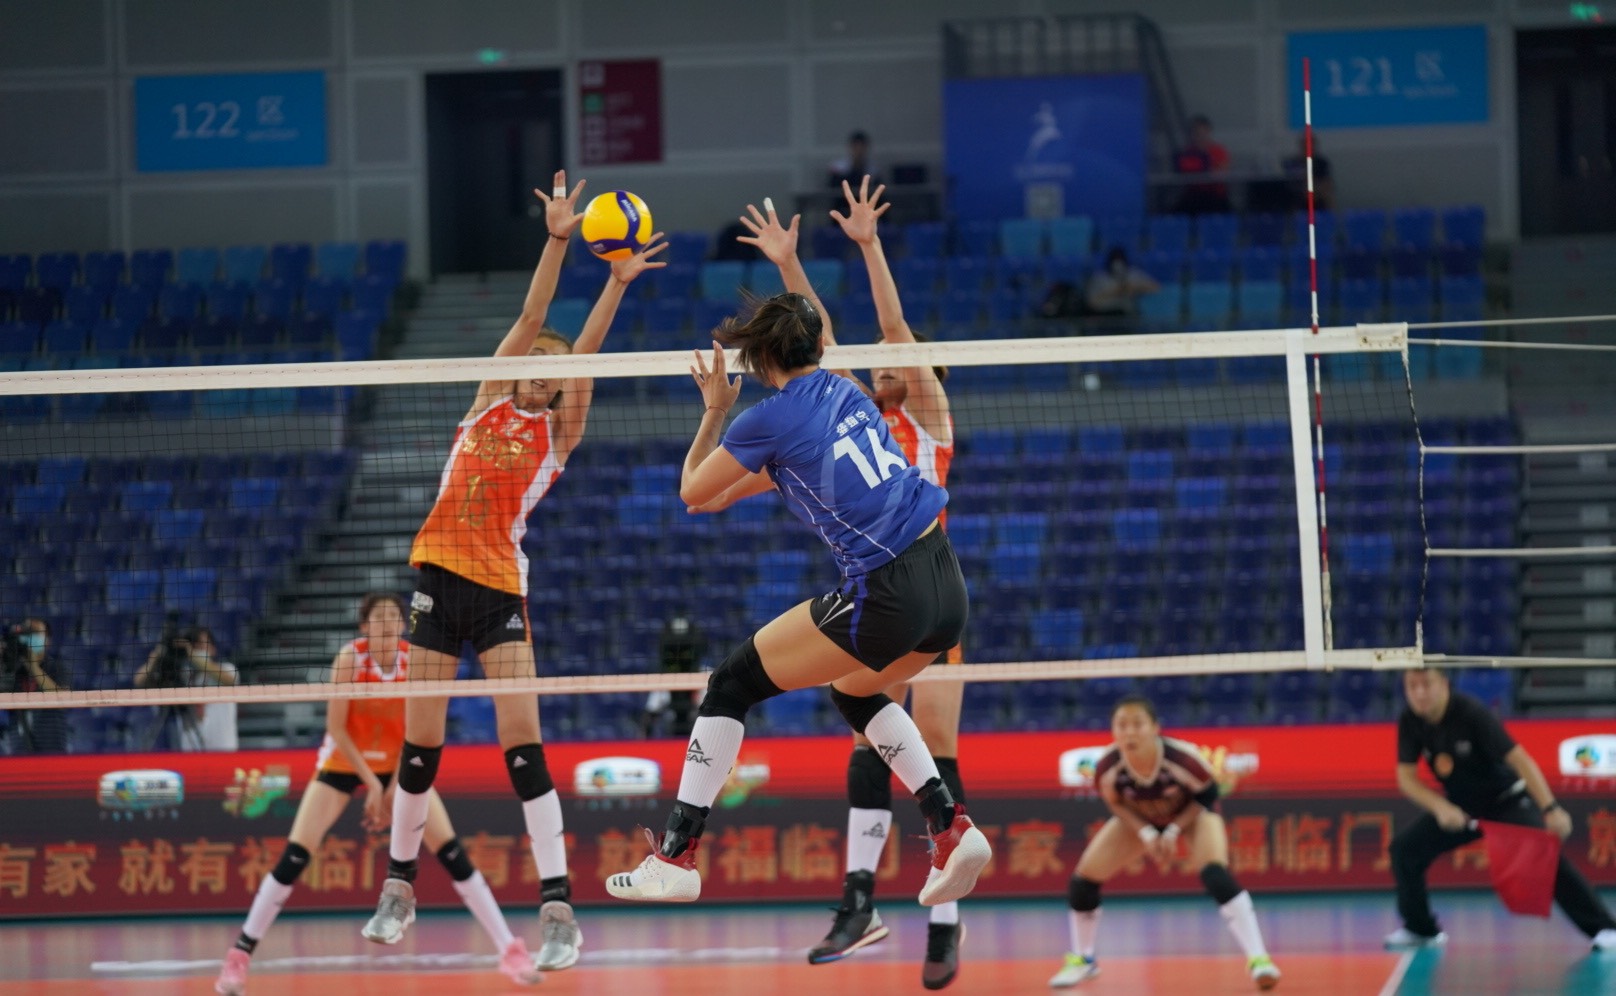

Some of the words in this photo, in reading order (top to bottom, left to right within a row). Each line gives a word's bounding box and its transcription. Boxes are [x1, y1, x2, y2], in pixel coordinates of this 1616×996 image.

[1325, 56, 1396, 97] 121
[171, 101, 241, 140] 122
[833, 427, 907, 489] 16
